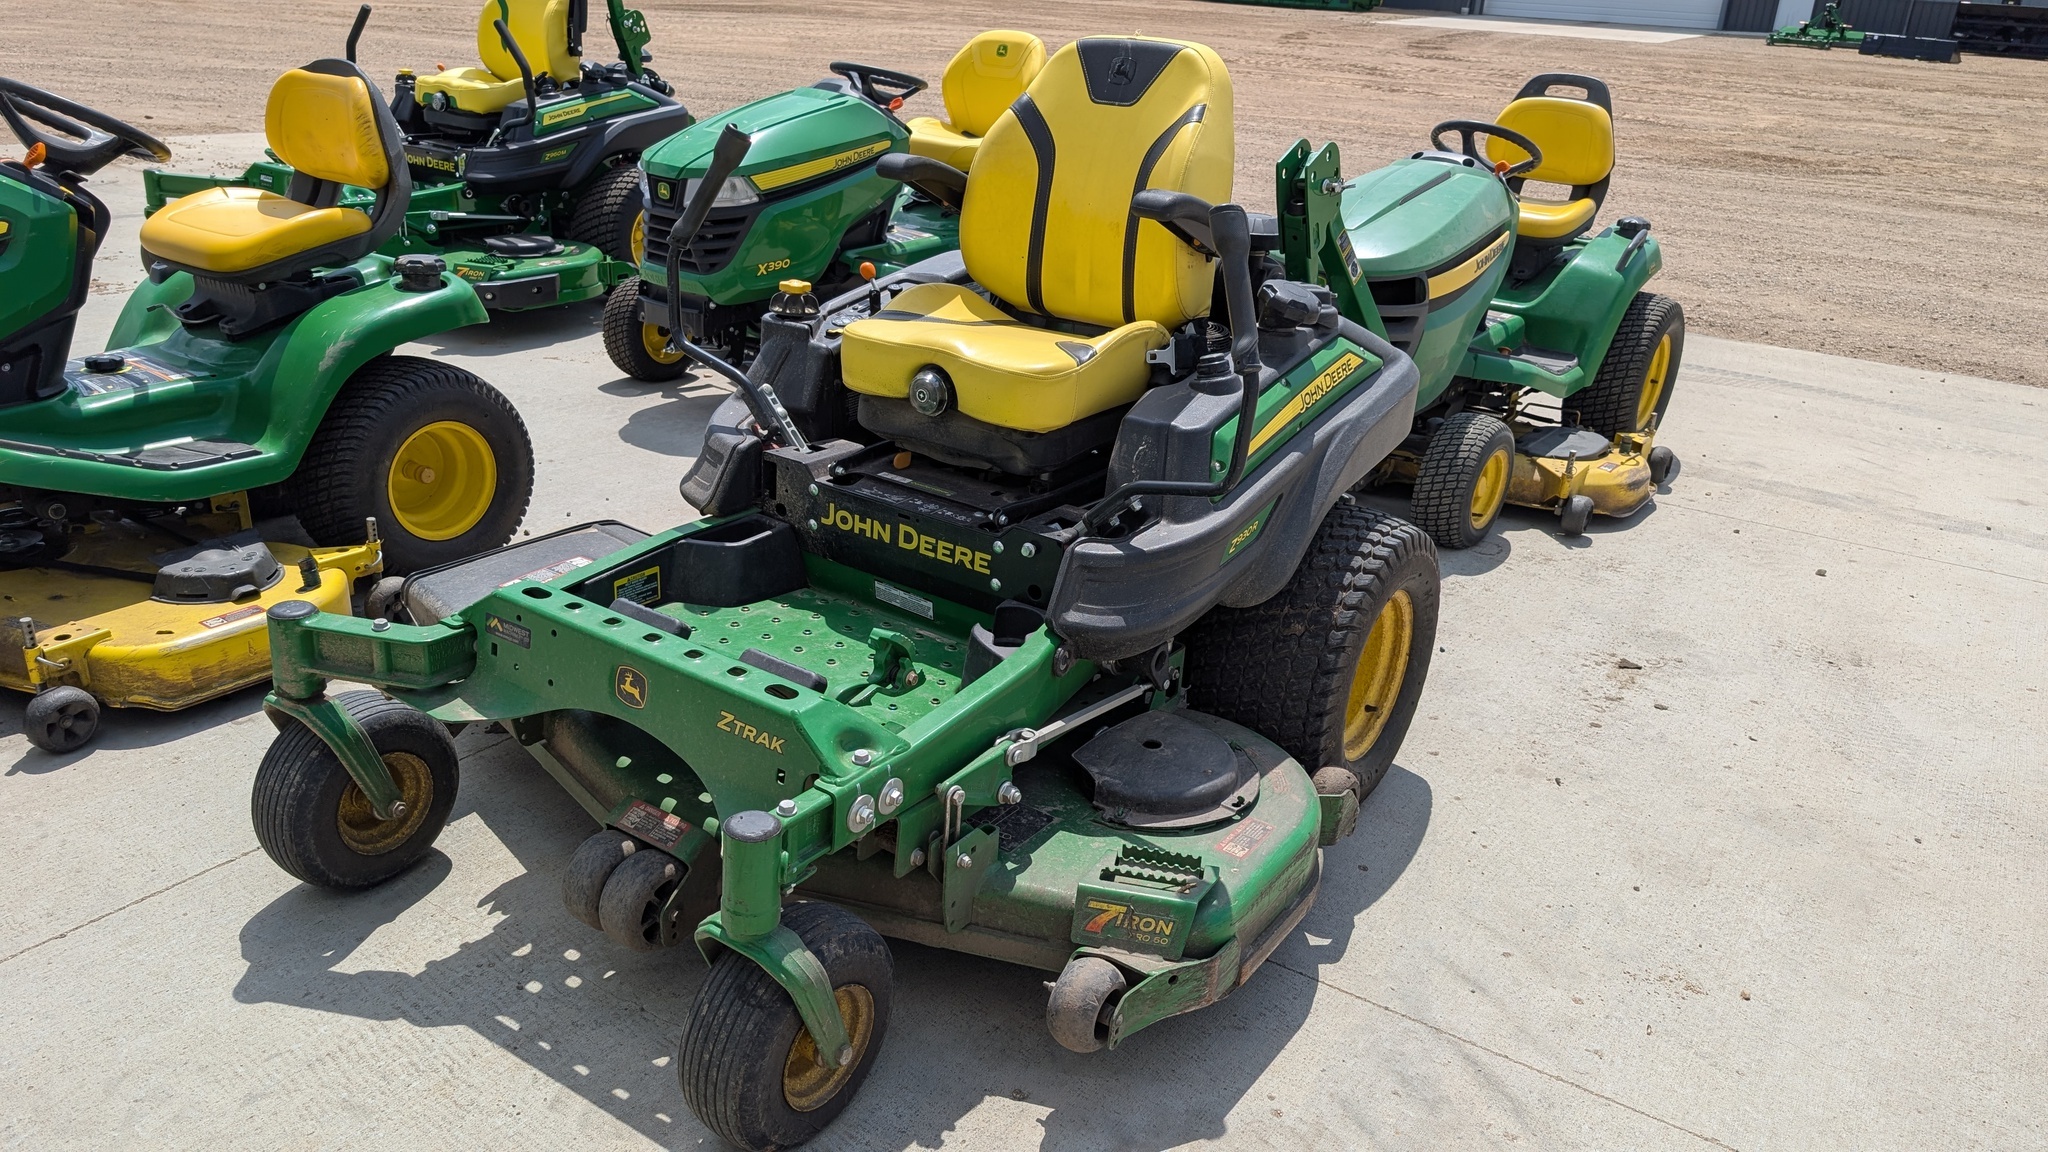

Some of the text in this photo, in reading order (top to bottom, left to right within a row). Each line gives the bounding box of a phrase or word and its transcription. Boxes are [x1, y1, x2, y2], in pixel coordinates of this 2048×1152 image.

[548, 108, 581, 121] JOHN DEERE
[426, 156, 456, 172] DEERE
[832, 146, 876, 170] JOHN DEERE
[456, 266, 486, 278] 7 IRON
[757, 258, 791, 277] X390
[1299, 358, 1353, 412] JOHN DEERE
[820, 502, 891, 544] JOHN
[898, 523, 992, 575] DEERE
[1228, 520, 1259, 554] Z930R
[716, 710, 787, 754] ZTRAK
[1085, 900, 1175, 936] 7 IRON
[1134, 932, 1151, 943] RO
